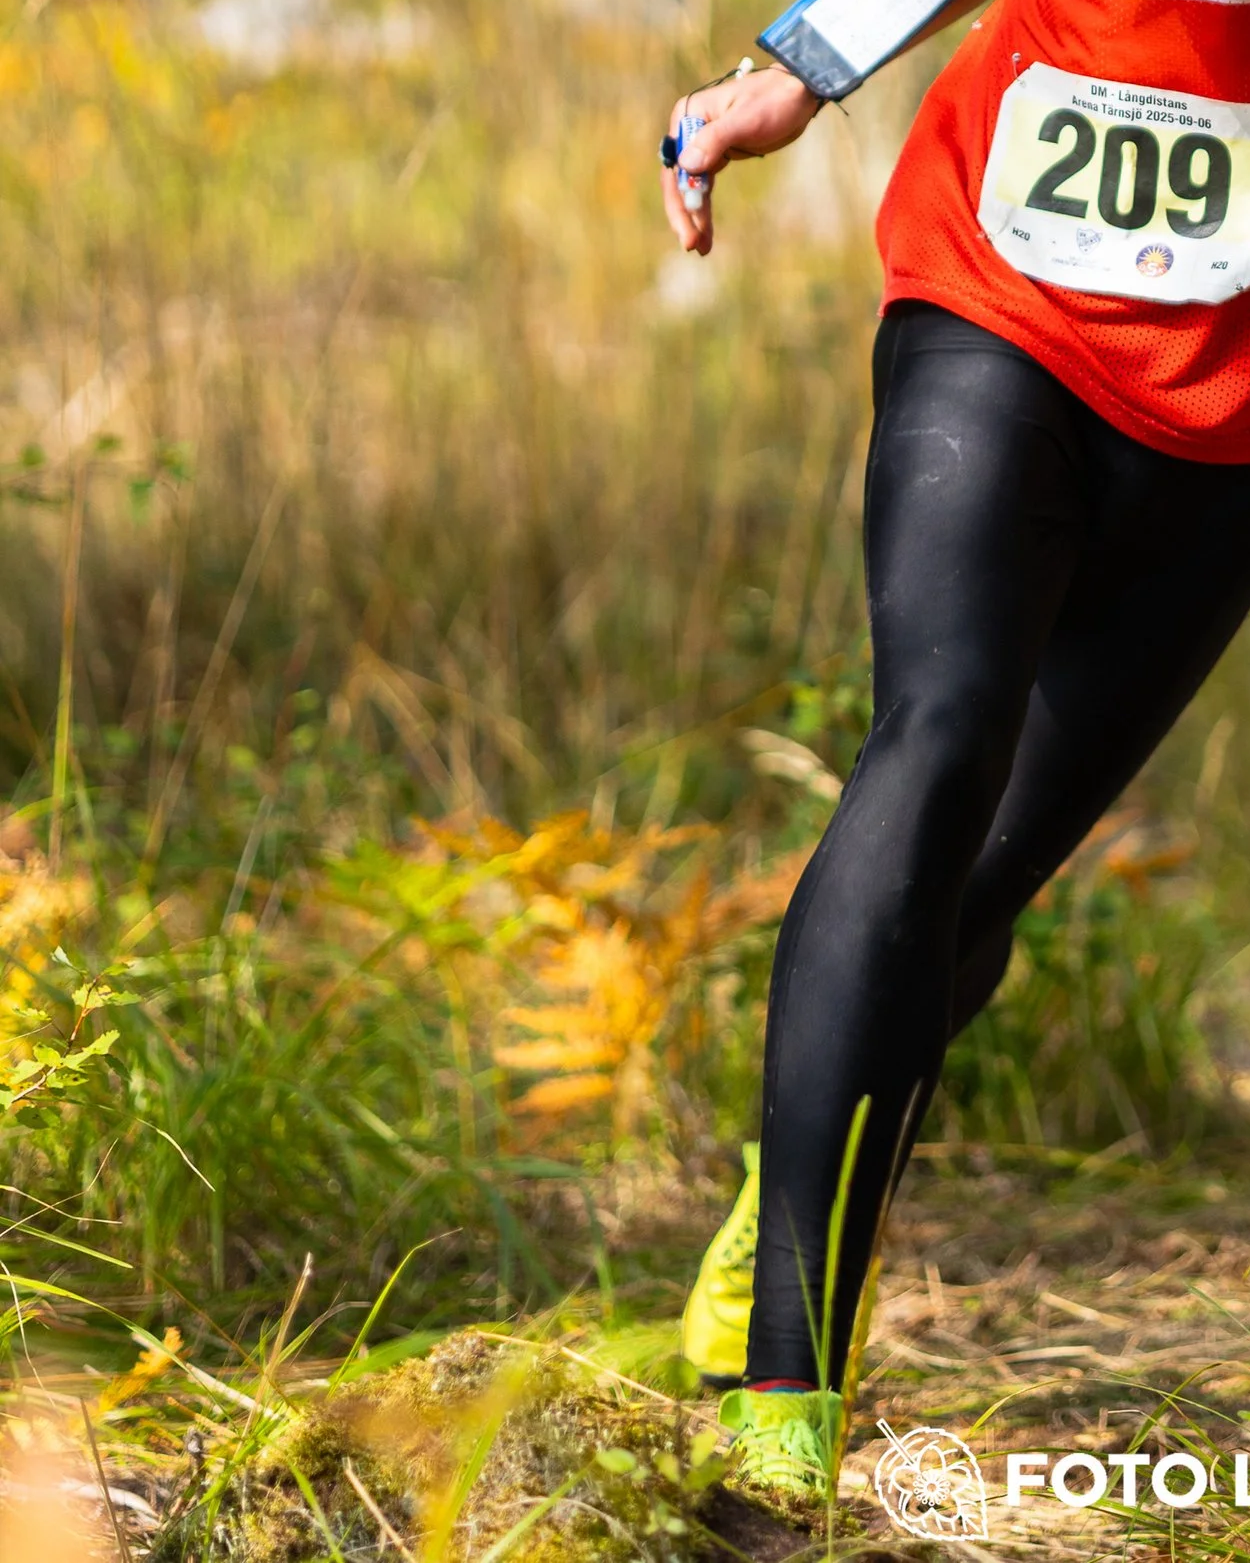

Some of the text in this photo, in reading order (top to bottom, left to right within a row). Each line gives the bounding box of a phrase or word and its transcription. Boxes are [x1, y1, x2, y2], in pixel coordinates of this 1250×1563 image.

[1071, 95, 1212, 129] Arena Tärnsjö 2025-09-06
[1090, 84, 1107, 98] DM
[1118, 89, 1188, 110] Långdistans
[1025, 107, 1232, 239] 209
